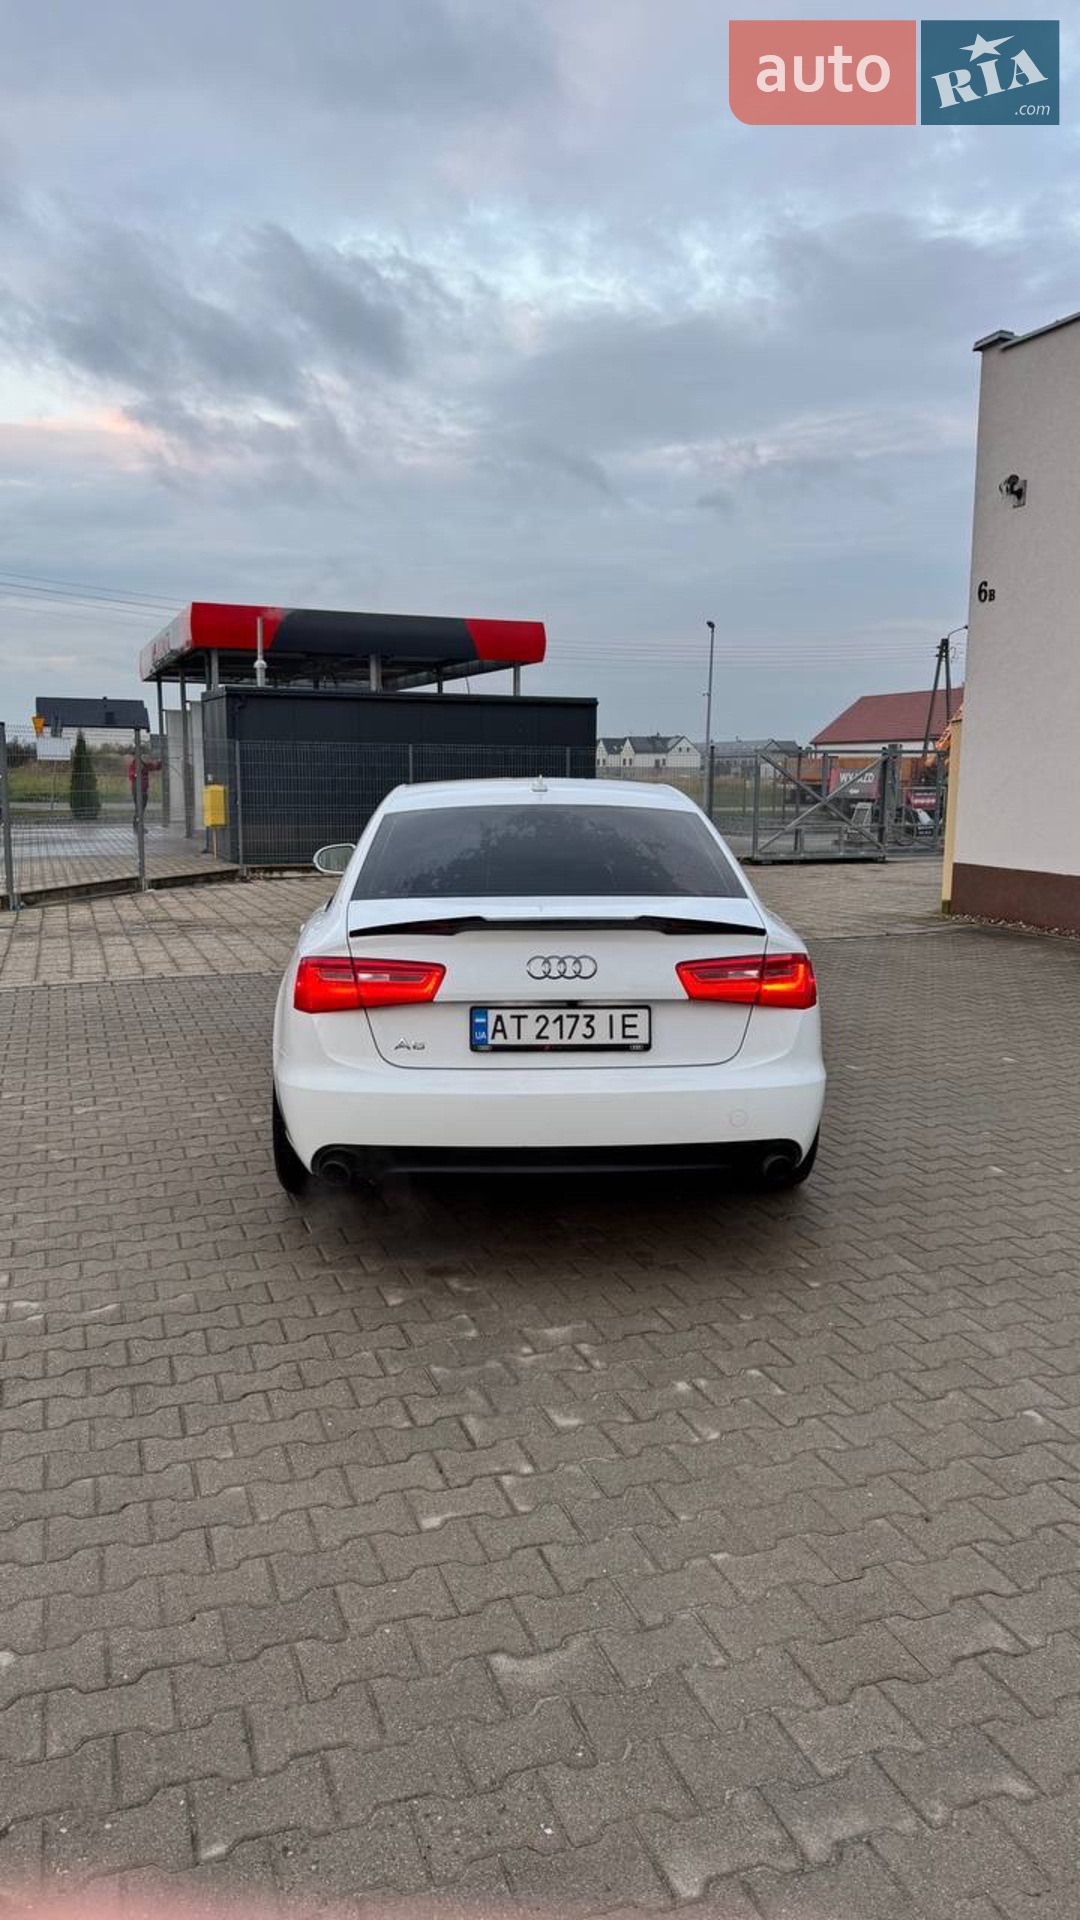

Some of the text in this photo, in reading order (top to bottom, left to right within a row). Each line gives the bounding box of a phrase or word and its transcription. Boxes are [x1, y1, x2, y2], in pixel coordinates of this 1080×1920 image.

[475, 1031, 487, 1040] UA
[491, 1014, 639, 1040] AT 2173 IE
